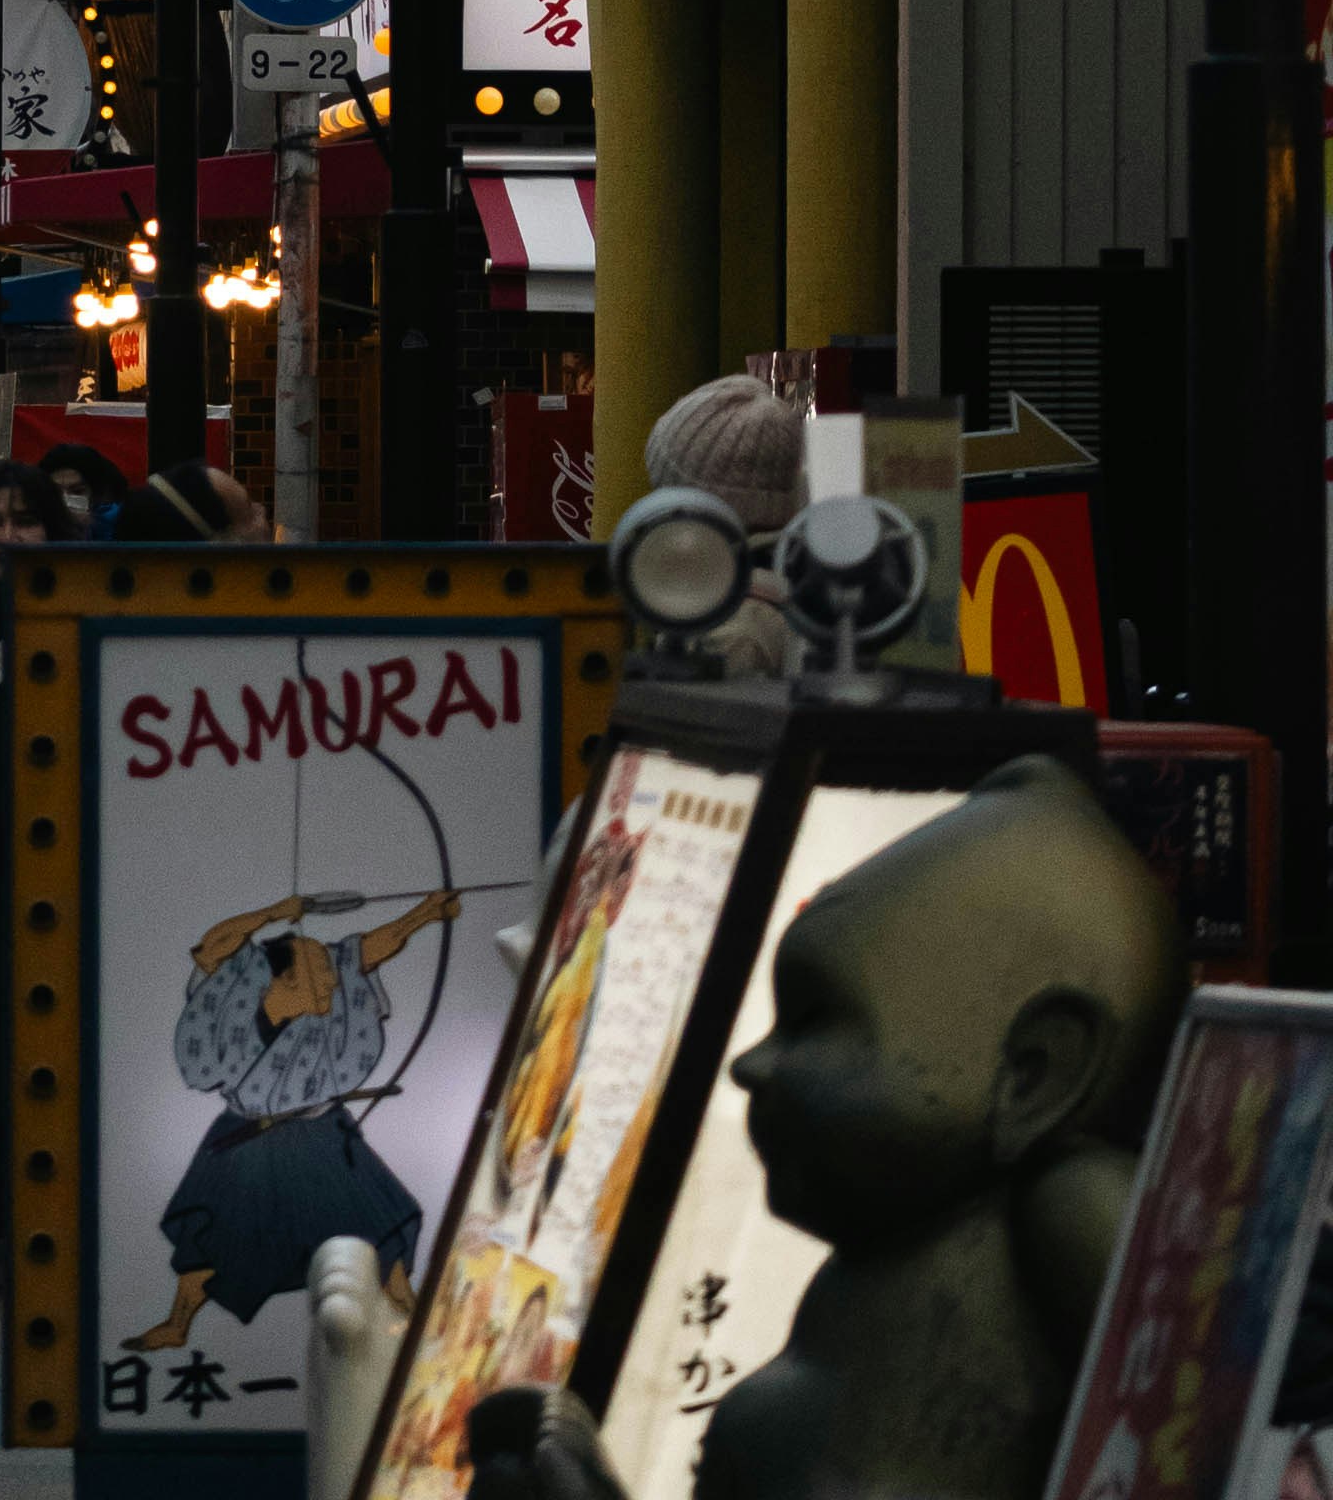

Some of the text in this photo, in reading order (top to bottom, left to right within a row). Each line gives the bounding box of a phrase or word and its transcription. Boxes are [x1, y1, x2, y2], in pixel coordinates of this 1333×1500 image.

[119, 647, 523, 780] SAMURAI
[100, 1350, 300, 1418] 日本一
